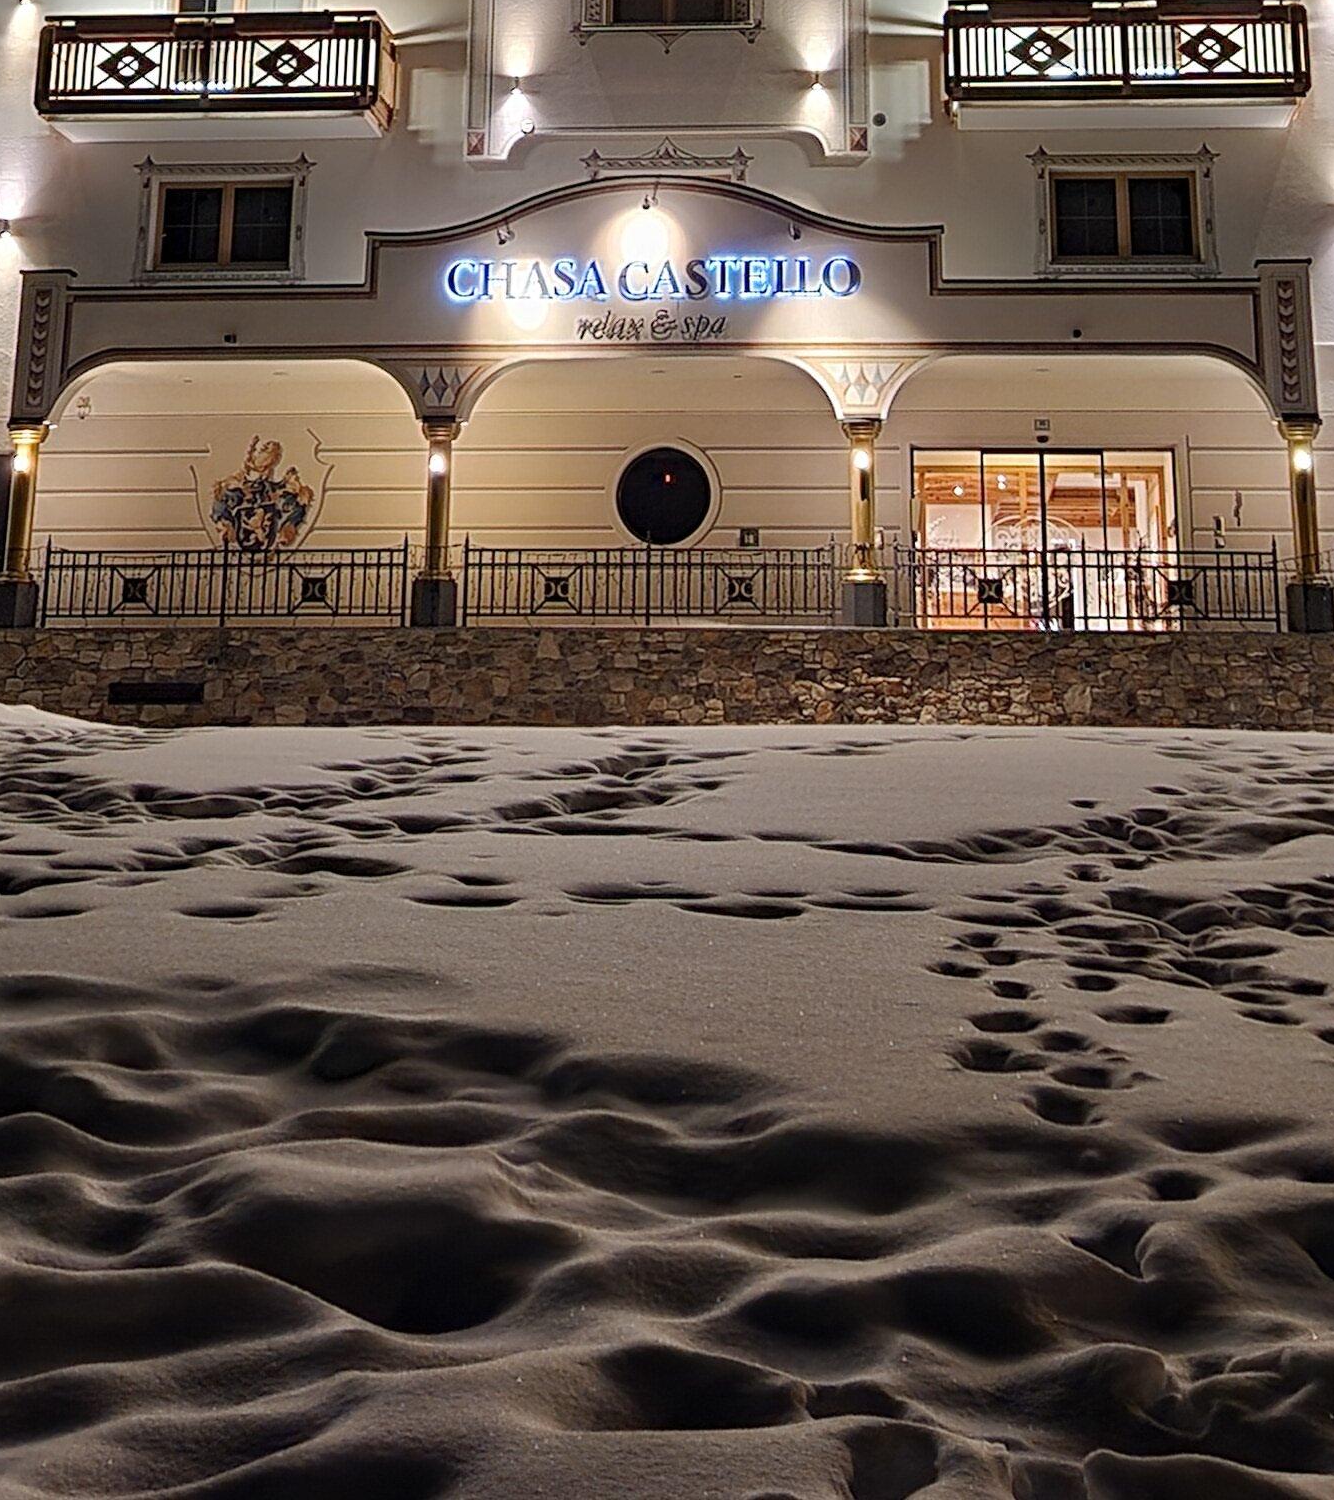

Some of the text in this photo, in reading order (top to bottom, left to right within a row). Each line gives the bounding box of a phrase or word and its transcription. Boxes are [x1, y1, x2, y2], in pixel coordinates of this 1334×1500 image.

[446, 255, 863, 301] CHASA CASTELLO
[577, 308, 728, 341] relax & spa
